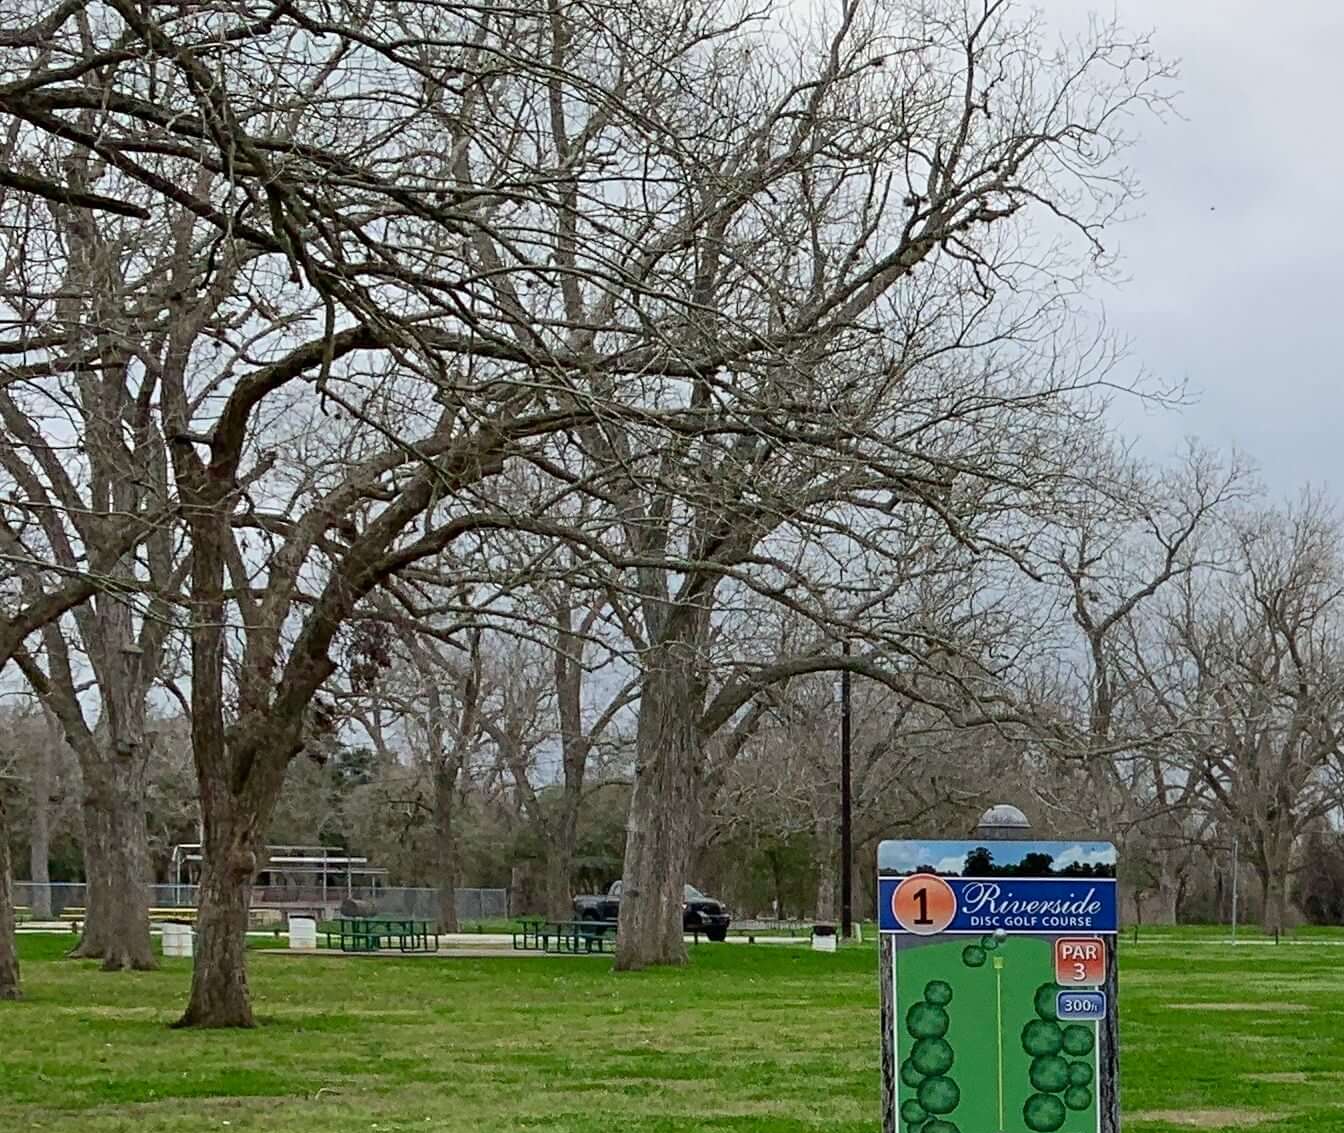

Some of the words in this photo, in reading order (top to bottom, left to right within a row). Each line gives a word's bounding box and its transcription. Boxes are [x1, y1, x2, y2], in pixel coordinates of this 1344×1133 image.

[912, 887, 934, 925] 1
[961, 881, 1102, 915] Riverside
[970, 916, 1000, 927] DISC
[1004, 916, 1038, 927] GOLF
[1041, 916, 1092, 927] COURSE
[1062, 944, 1097, 960] PAR
[1073, 962, 1087, 981] 3
